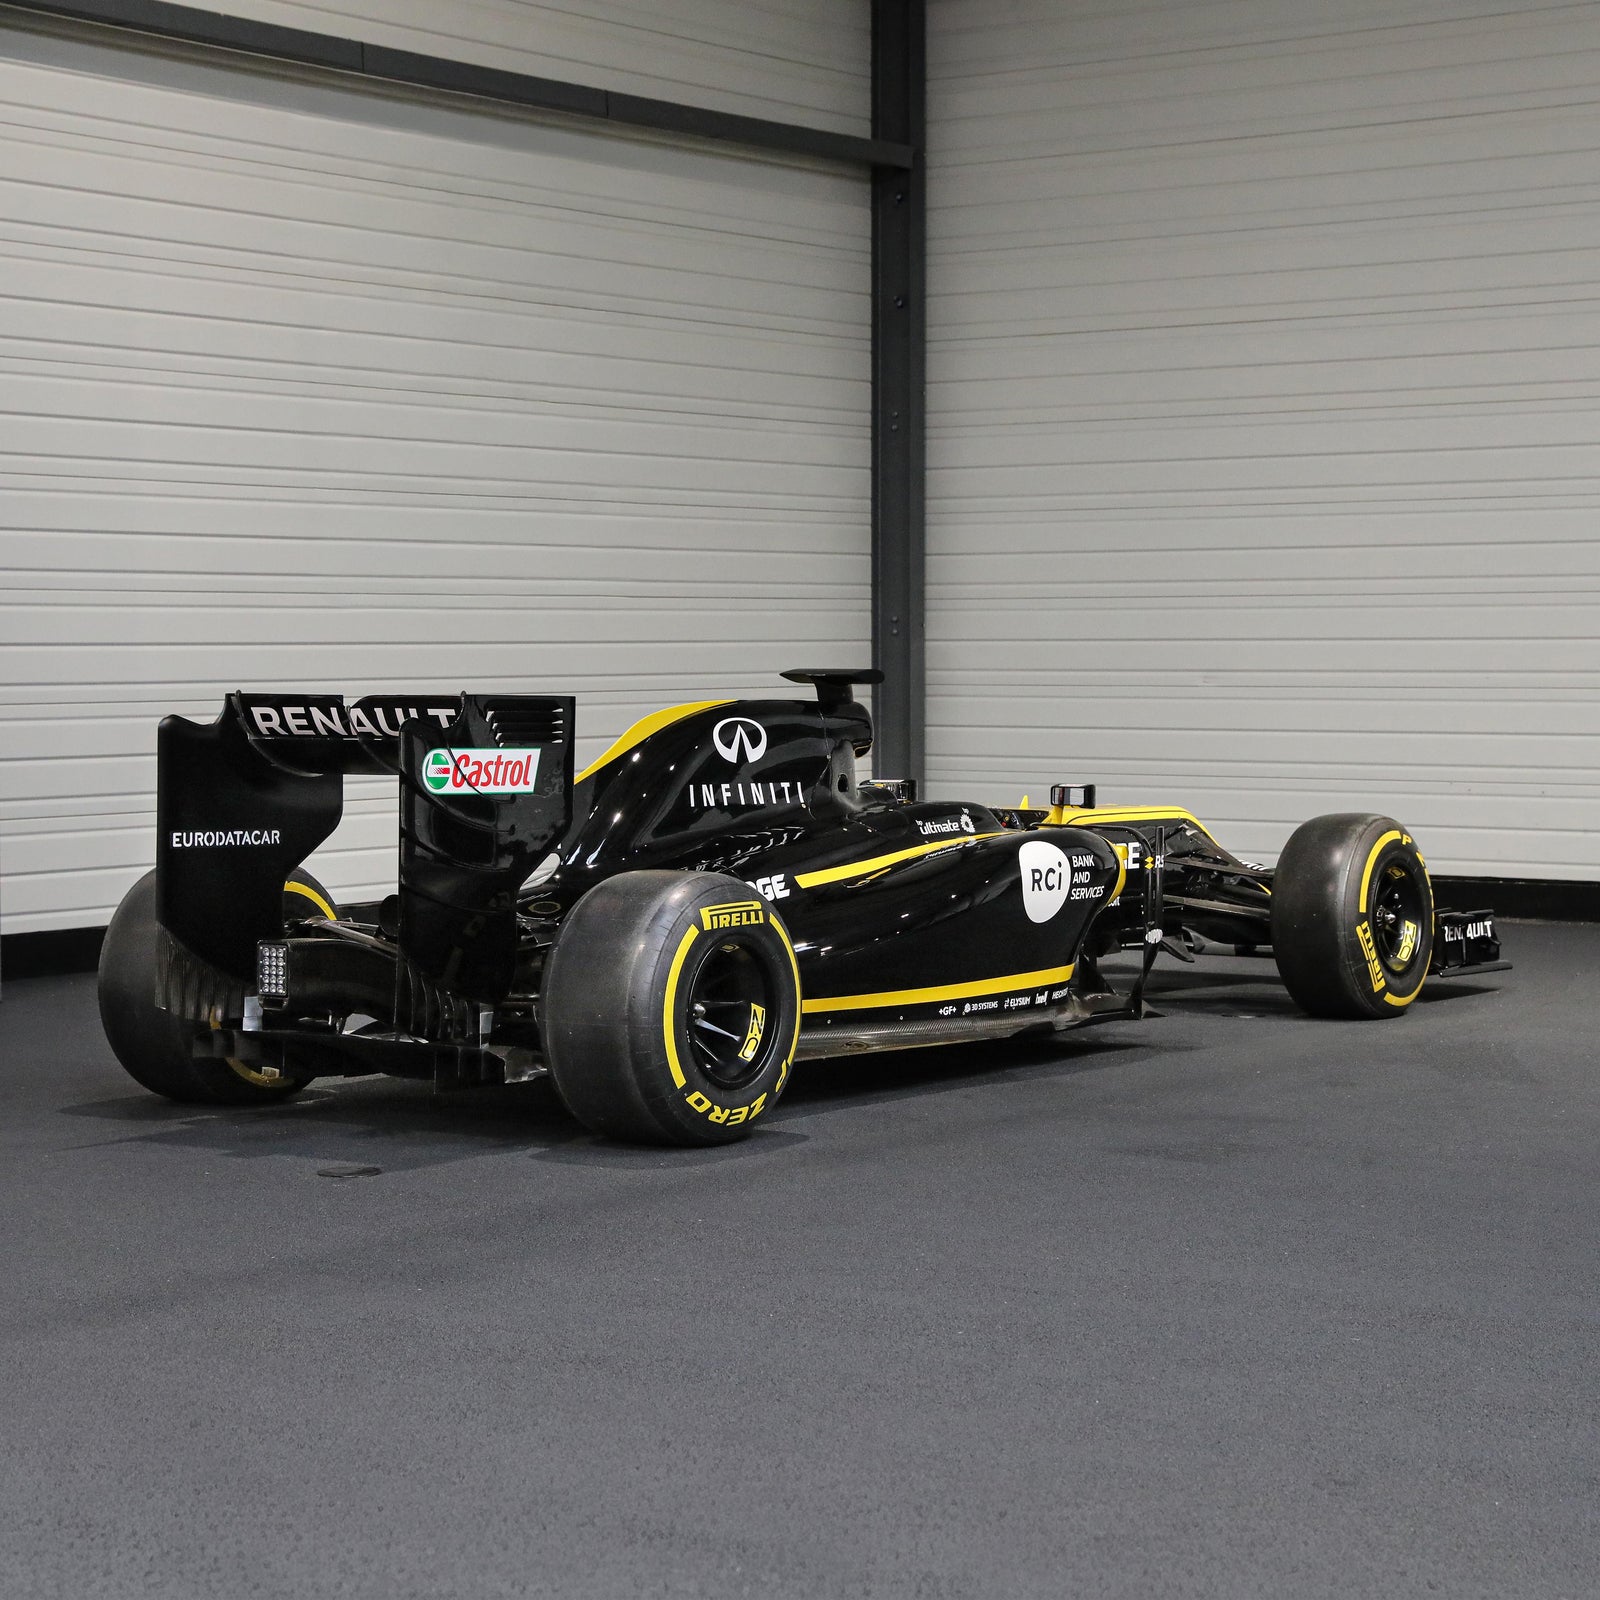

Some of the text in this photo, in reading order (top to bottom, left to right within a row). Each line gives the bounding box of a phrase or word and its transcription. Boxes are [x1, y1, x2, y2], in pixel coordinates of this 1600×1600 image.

[452, 754, 532, 788] Castrol
[689, 782, 805, 807] INFINITI
[172, 830, 280, 848] EURODATACAR
[920, 819, 961, 835] ultimate
[1072, 855, 1095, 867] BANK
[744, 873, 791, 901] GE
[1031, 861, 1063, 892] RCi
[1072, 872, 1091, 884] AND
[1070, 886, 1105, 900] SERVICES
[699, 900, 764, 931] PIRELLI
[1356, 921, 1387, 993] PIRELLI
[978, 1001, 998, 1010] SYSTEMS
[686, 1091, 768, 1126] ZERO
